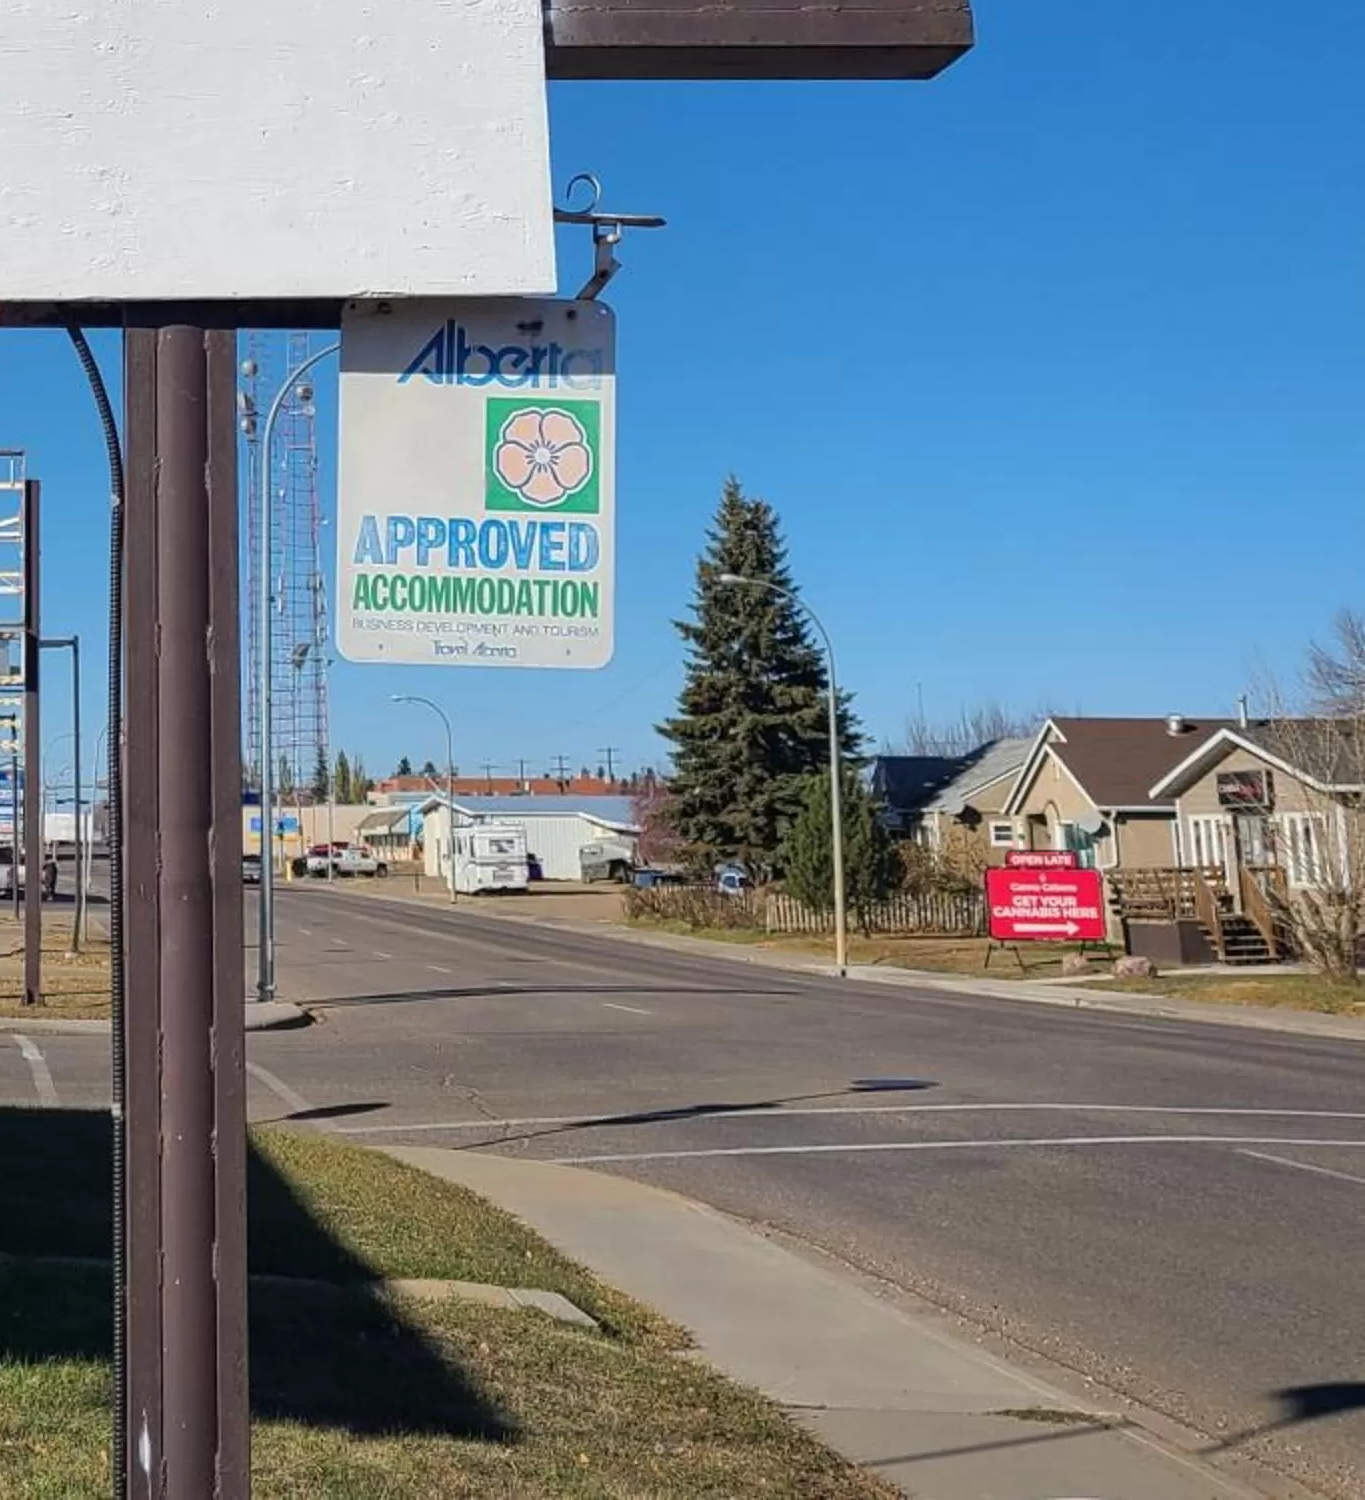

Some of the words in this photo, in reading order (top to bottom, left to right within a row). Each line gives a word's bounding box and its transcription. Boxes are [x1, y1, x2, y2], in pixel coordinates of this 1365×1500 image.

[396, 318, 603, 391] Alberta
[354, 515, 600, 573] APPROVED
[352, 573, 600, 618] ACCOMMODATION
[352, 618, 414, 631] BUSINESS
[416, 620, 508, 636] DEVELOPMENT
[512, 623, 539, 636] AND
[542, 625, 600, 637] TOURISM
[1010, 855, 1043, 866] OPEN
[1045, 855, 1072, 866] LATE
[1012, 895, 1037, 907] GET
[1040, 895, 1077, 907] YOUR
[992, 906, 1061, 918] CANNABIS
[1062, 907, 1098, 919] HERE
